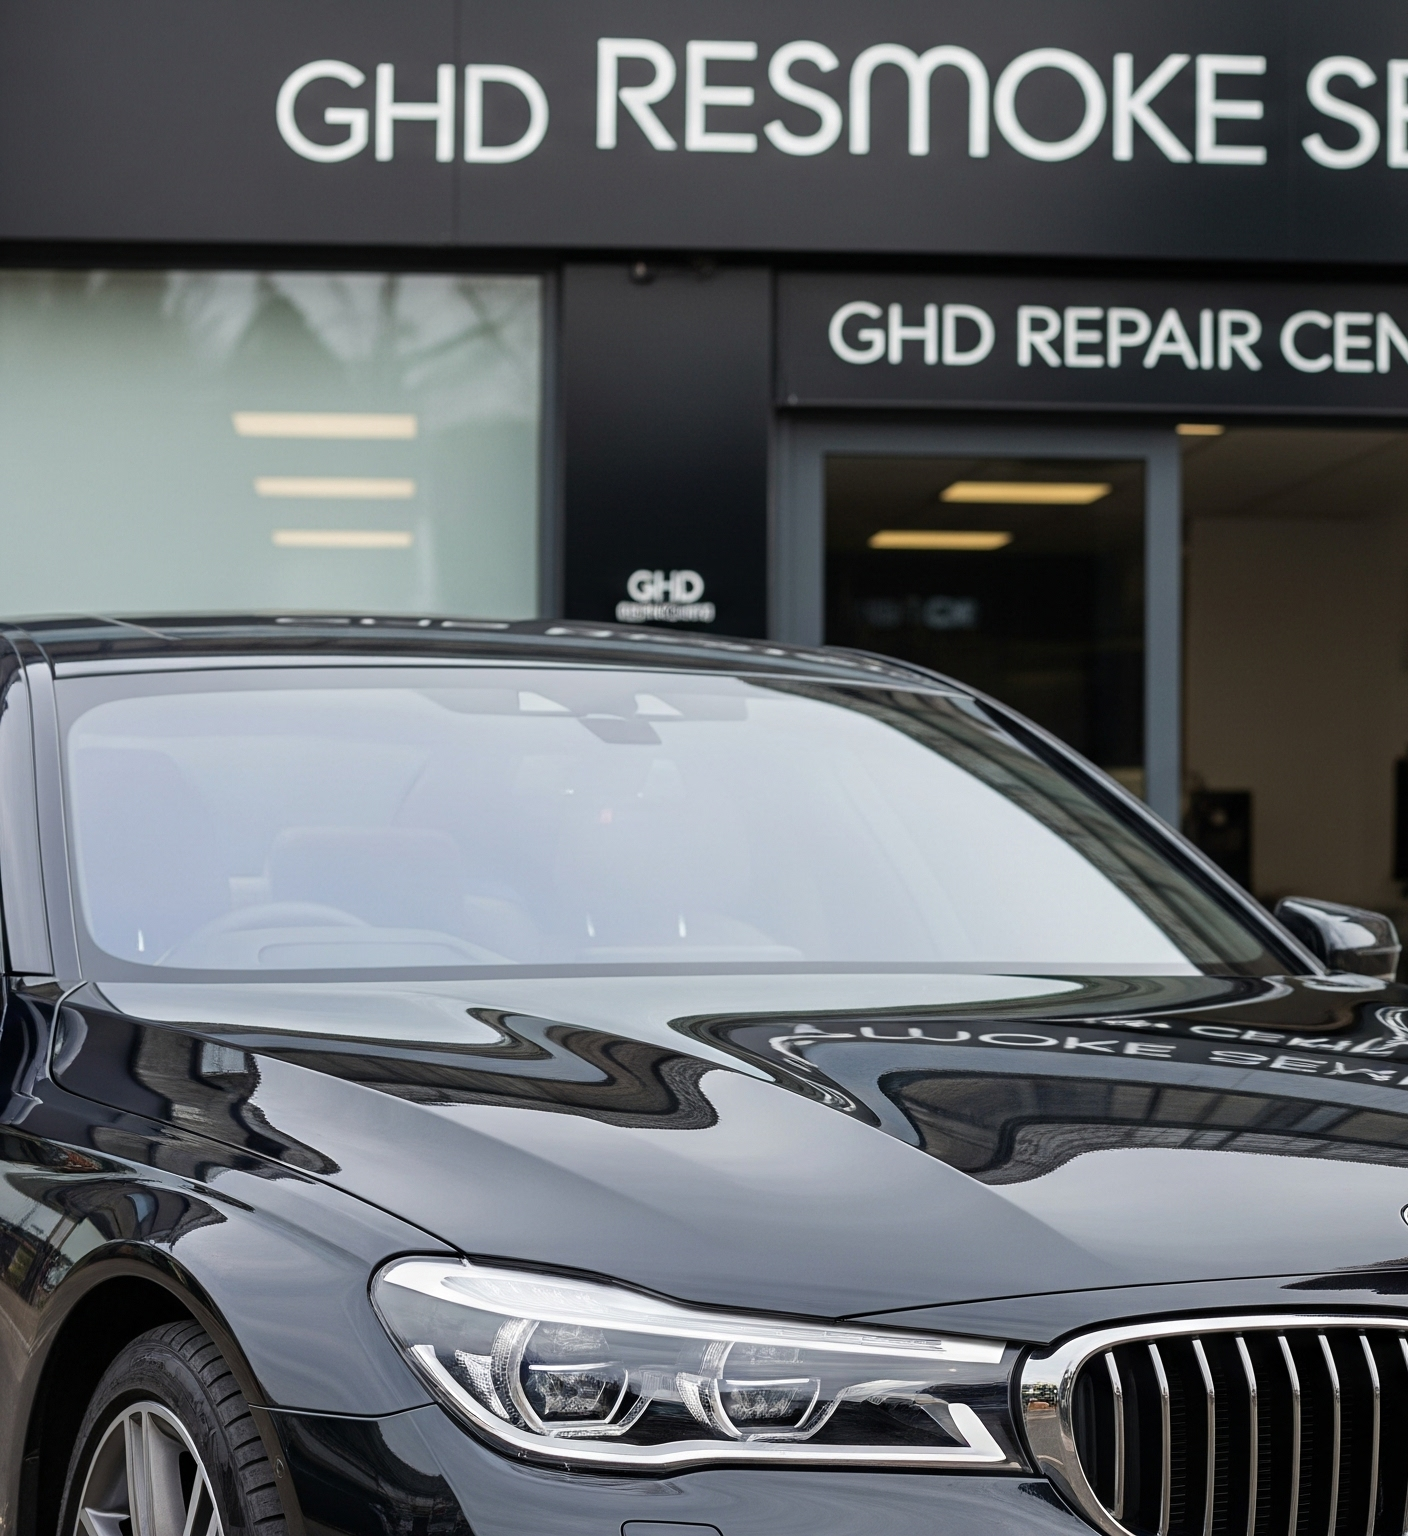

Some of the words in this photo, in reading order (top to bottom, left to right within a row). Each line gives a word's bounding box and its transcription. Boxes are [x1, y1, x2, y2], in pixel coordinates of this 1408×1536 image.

[276, 59, 549, 164] GHD
[596, 37, 1266, 164] RESMOKE
[829, 302, 994, 365] GHD
[1017, 306, 1262, 370] REPAIR
[627, 569, 705, 603] GHD
